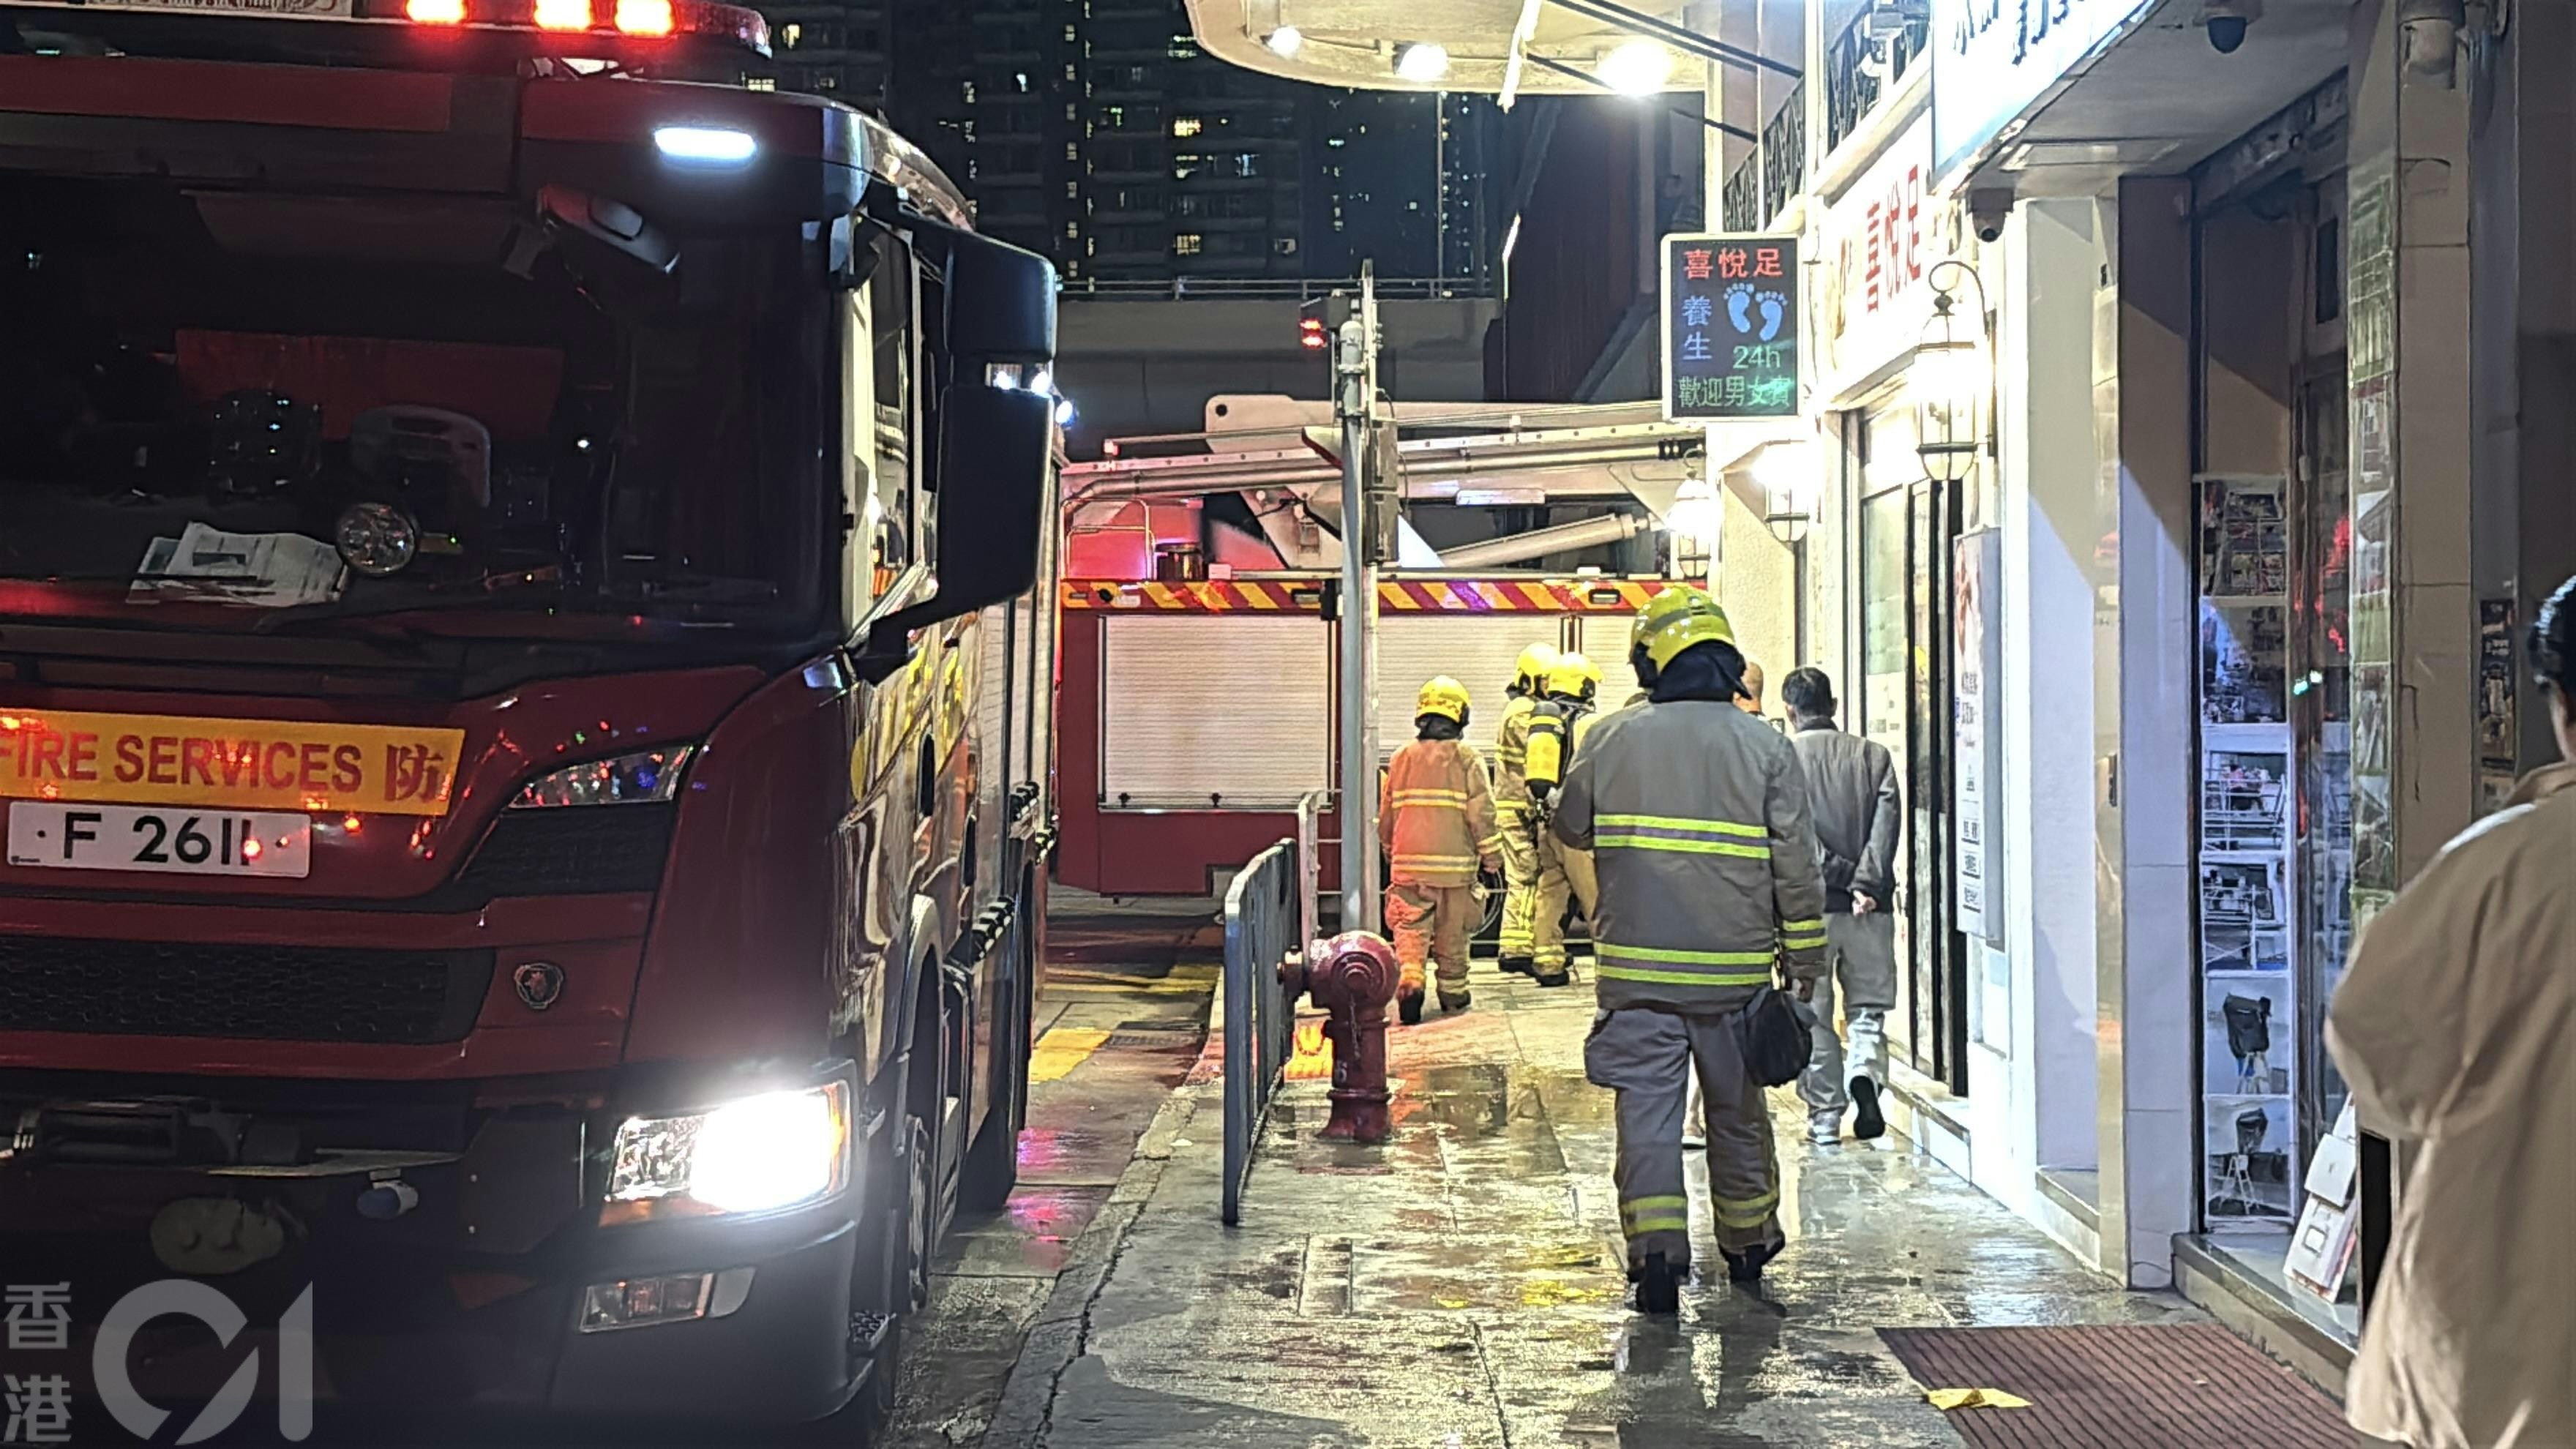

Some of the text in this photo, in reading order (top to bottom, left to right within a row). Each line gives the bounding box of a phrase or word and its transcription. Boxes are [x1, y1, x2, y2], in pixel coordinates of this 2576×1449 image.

[1683, 247, 1783, 279] 喜悅足
[1682, 295, 1712, 360] 養生
[1733, 345, 1781, 369] 24h
[1678, 375, 1791, 408] 歡迎男女賓
[114, 734, 362, 793] SERVICES
[384, 743, 445, 802] 防
[64, 812, 252, 866] F 2611
